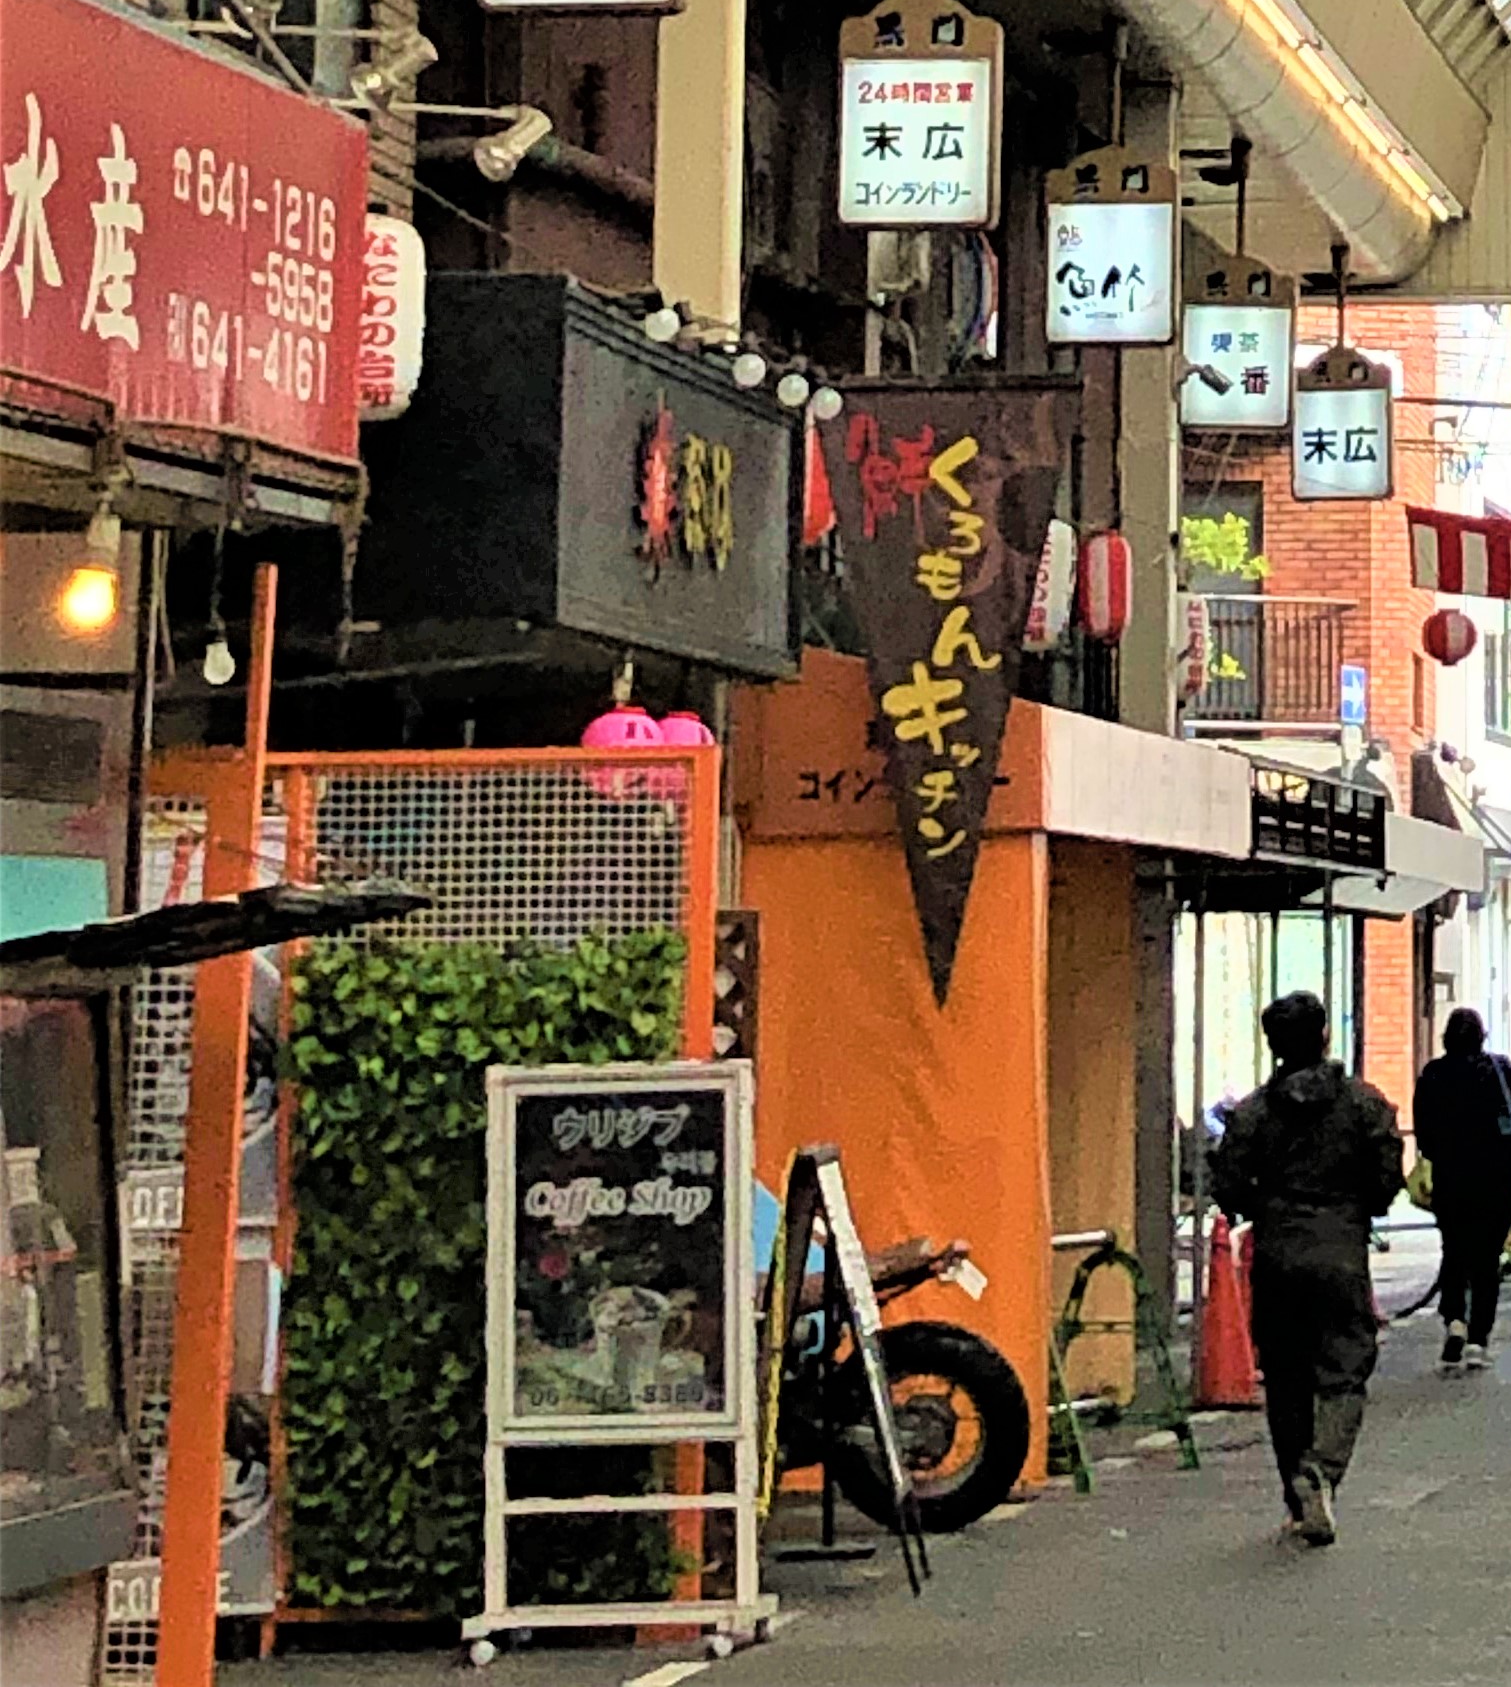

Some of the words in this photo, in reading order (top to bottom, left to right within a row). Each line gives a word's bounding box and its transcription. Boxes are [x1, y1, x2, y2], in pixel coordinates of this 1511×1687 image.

[858, 81, 974, 104] 24時間営業
[862, 122, 965, 161] 末広
[197, 148, 336, 262] 641-1216
[855, 182, 971, 205] コインランドリー
[1302, 427, 1378, 465] 末広
